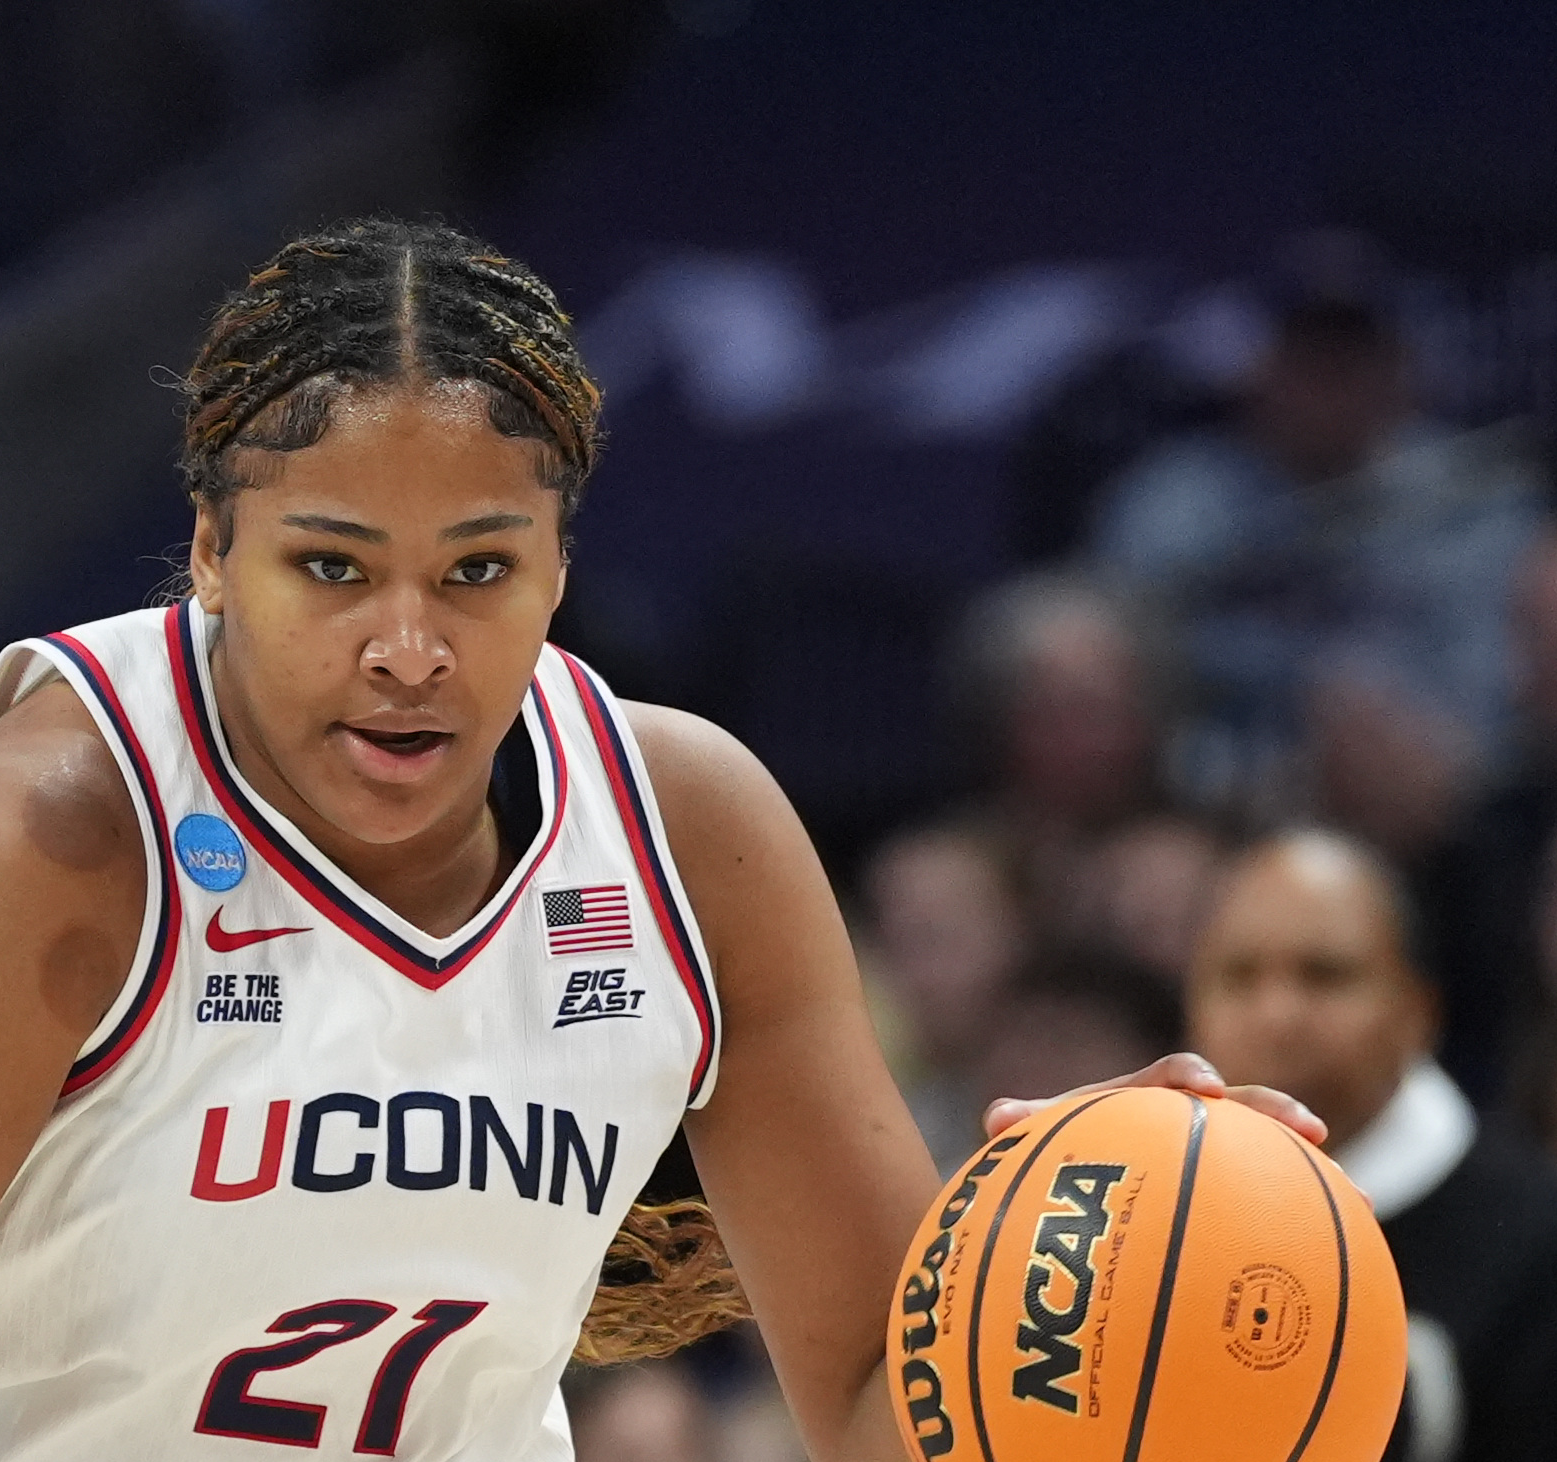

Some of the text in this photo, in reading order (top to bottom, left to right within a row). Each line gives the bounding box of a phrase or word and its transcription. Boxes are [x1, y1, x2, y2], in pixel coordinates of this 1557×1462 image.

[186, 849, 241, 871] NCAA
[197, 999, 283, 1024] CHANGE
[205, 974, 280, 998] BE THE
[558, 989, 645, 1015] EAST
[566, 968, 626, 994] BIG
[190, 1091, 619, 1217] UCONN
[942, 1228, 970, 1336] EVO NXT
[1010, 1161, 1128, 1417] NCAA
[1087, 1170, 1148, 1419] OFFICIAL GAME BALL
[193, 1298, 489, 1457] 21
